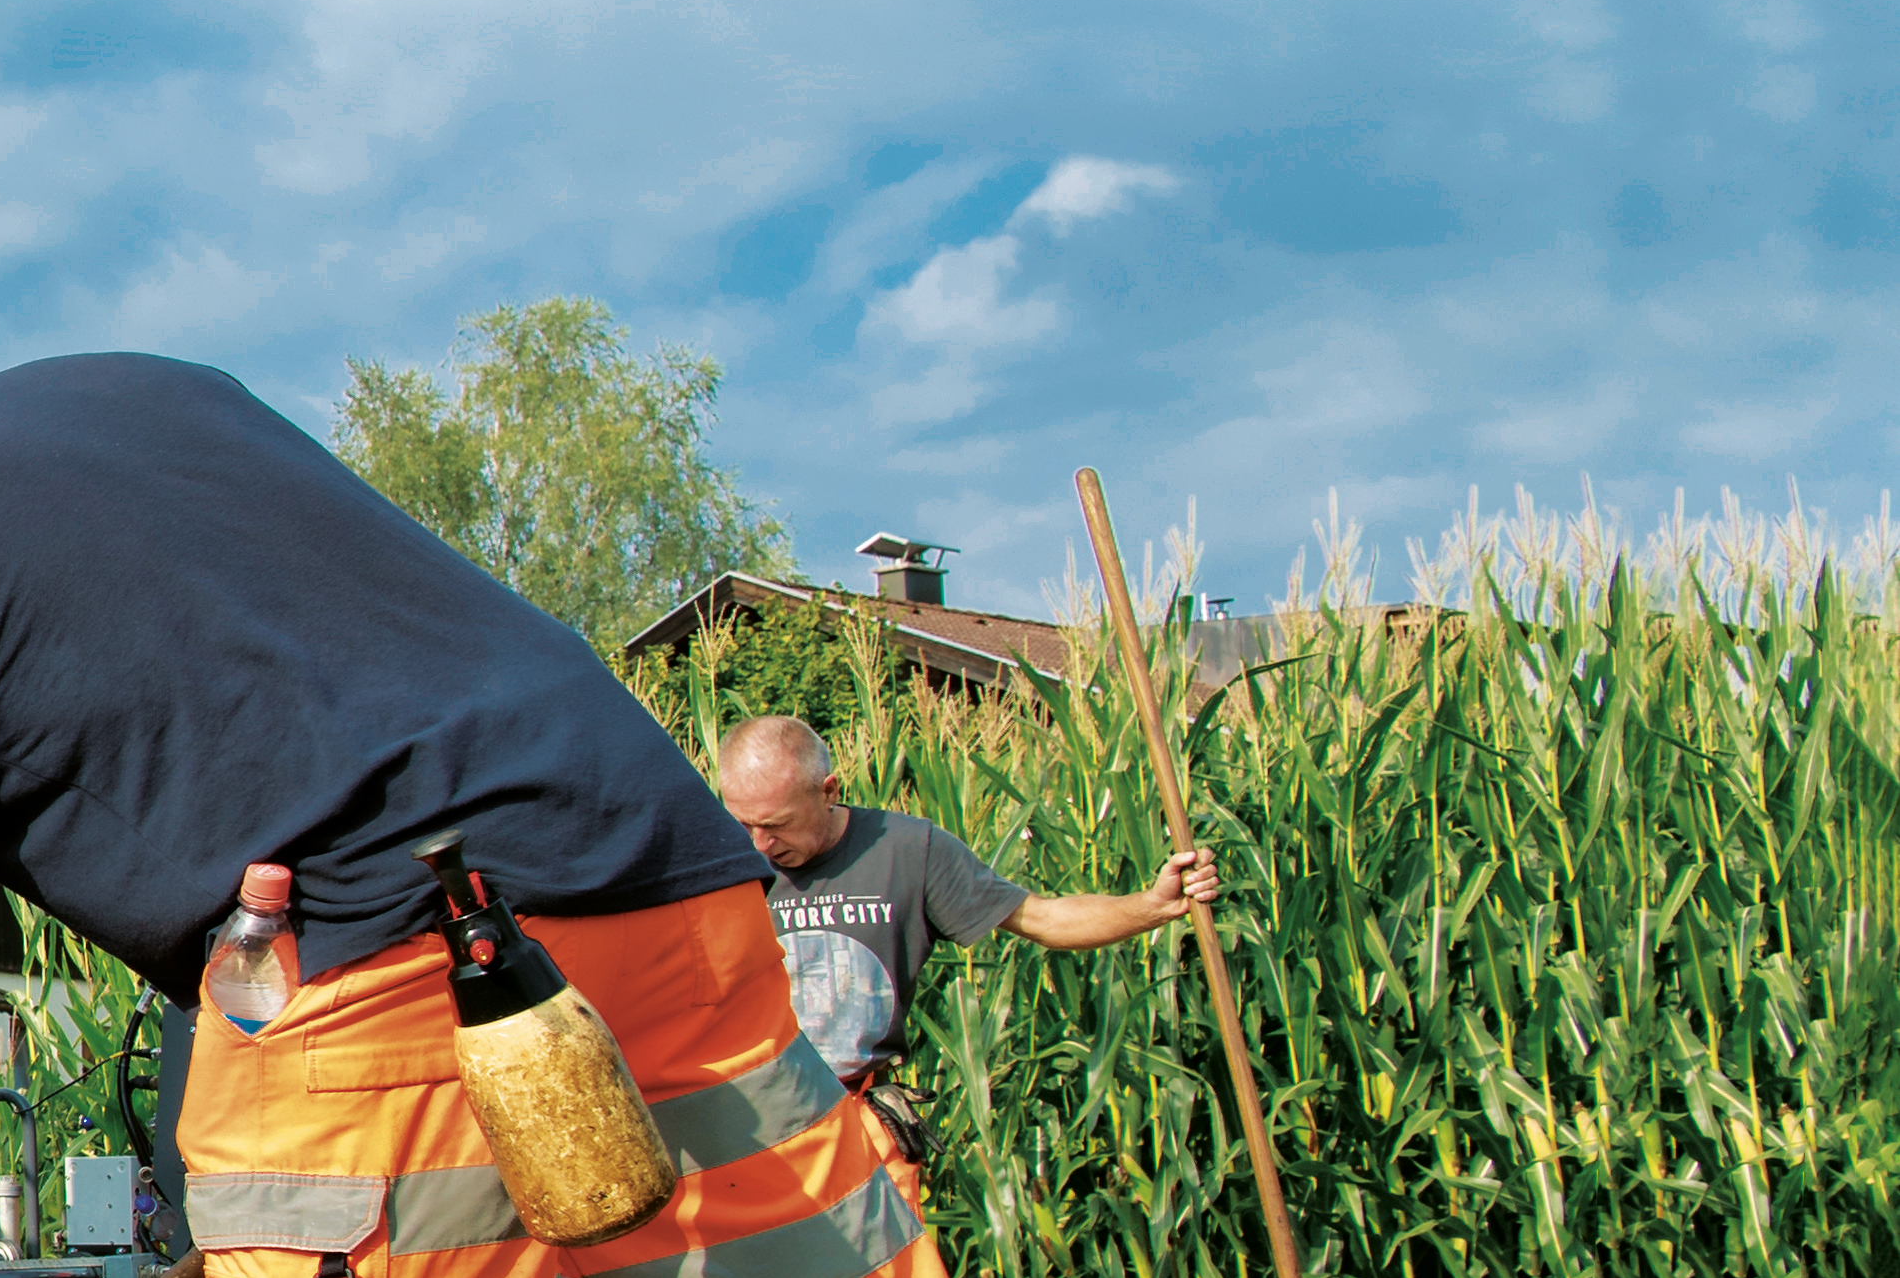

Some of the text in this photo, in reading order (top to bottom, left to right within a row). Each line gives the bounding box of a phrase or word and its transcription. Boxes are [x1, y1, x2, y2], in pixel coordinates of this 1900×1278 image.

[771, 898, 797, 910] JACK
[779, 902, 892, 930] YORK CITY
